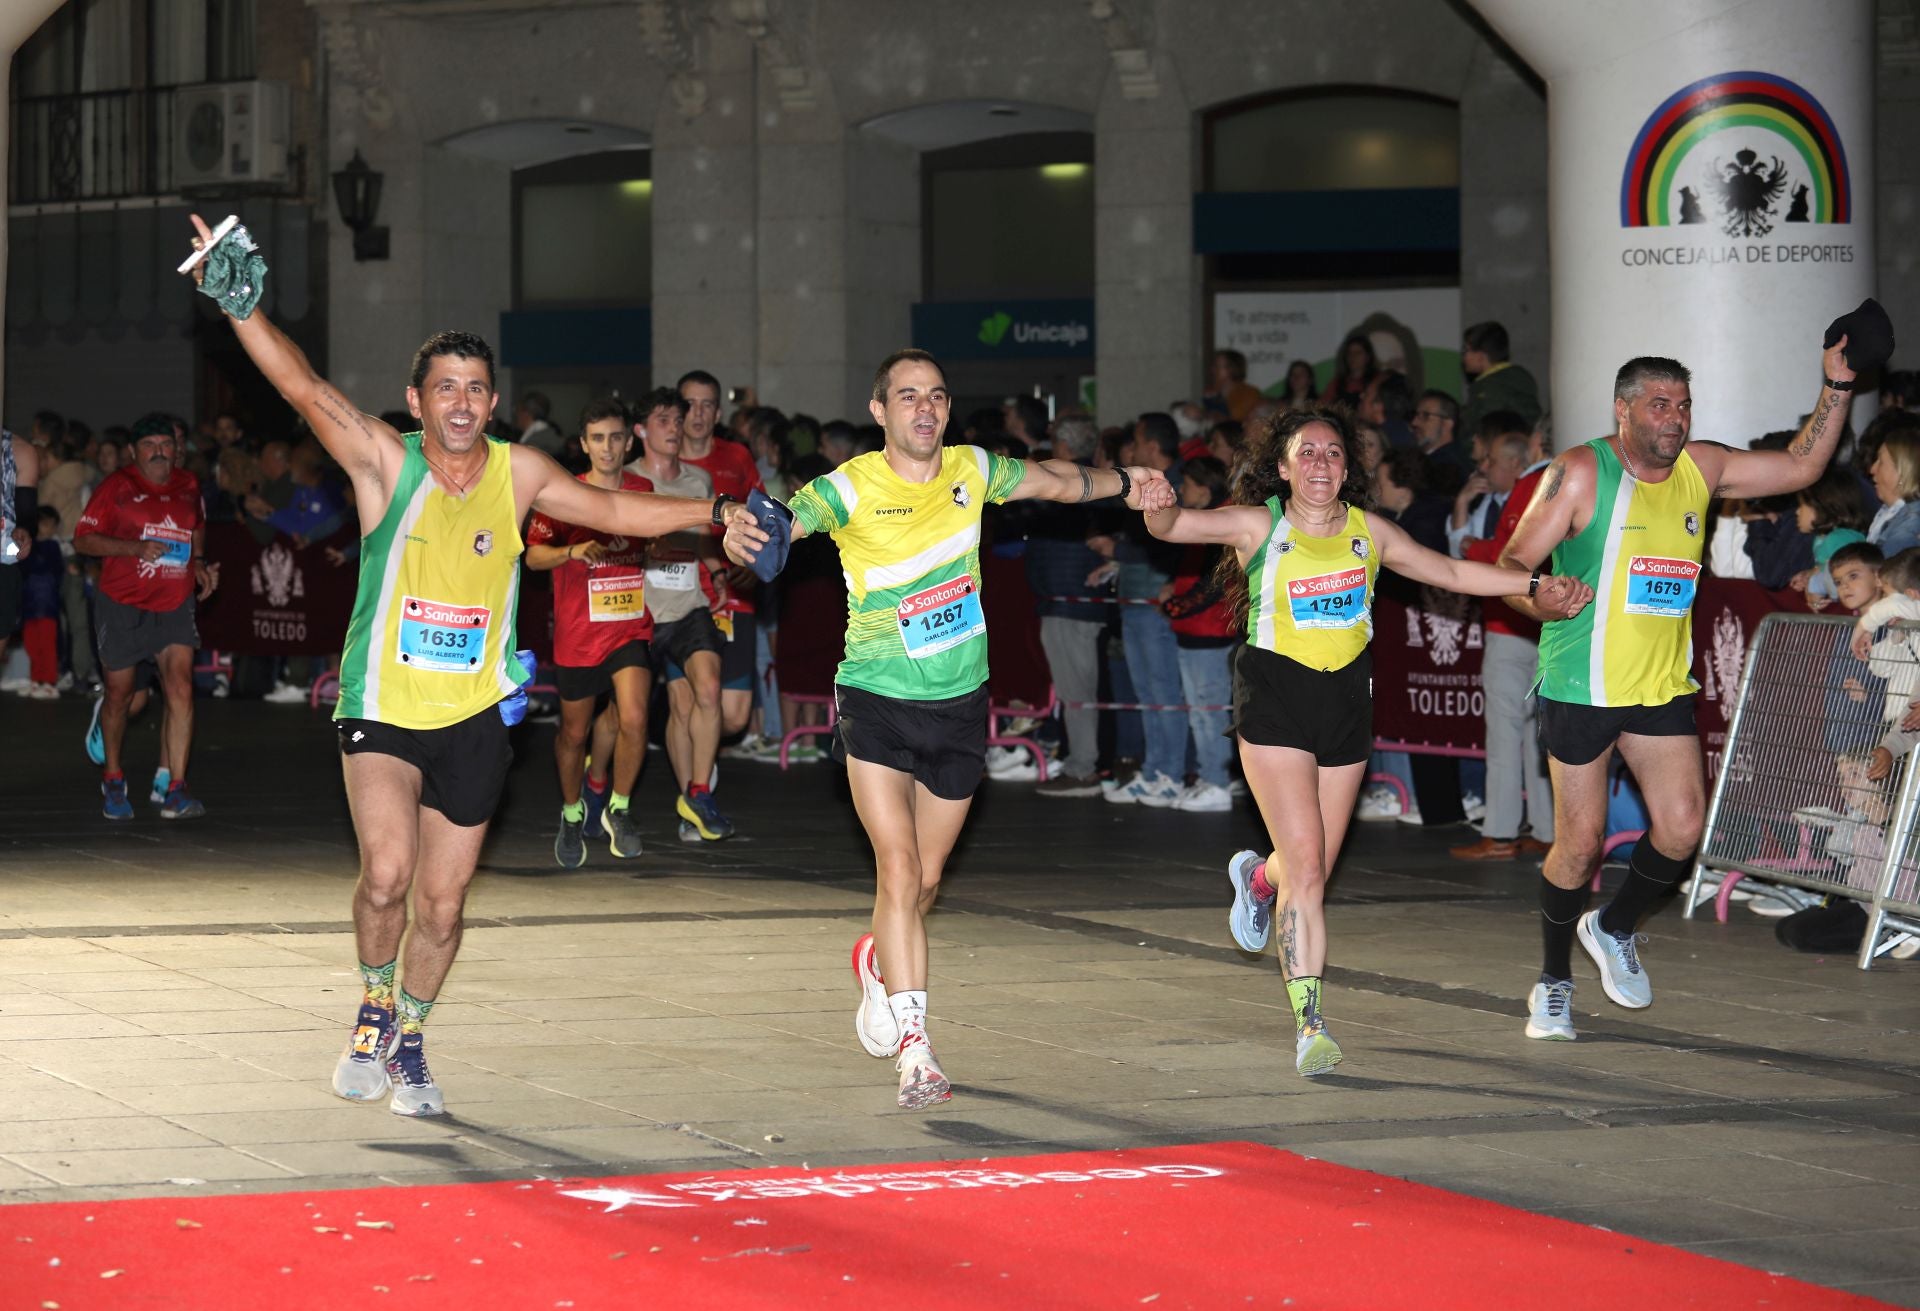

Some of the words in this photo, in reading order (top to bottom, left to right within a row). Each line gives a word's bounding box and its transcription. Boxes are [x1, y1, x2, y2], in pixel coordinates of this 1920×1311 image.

[1621, 247, 1740, 266] CONCEJALIA
[1746, 246, 1771, 264] DE
[1776, 245, 1854, 263] DEPORTES
[1227, 309, 1246, 325] Te
[1013, 320, 1089, 347] Unicaja
[1239, 331, 1252, 345] la
[1256, 331, 1289, 345] vida
[875, 506, 914, 516] evernya
[659, 564, 687, 574] 4607
[1647, 561, 1697, 576] Santander
[603, 580, 642, 590] Santander
[1308, 573, 1366, 593] Santander
[1645, 580, 1681, 595] 1679
[603, 593, 633, 605] 2132
[915, 580, 973, 609] Santander
[1309, 594, 1353, 612] 1794
[423, 606, 488, 625] Santander
[920, 603, 963, 631] 1267
[253, 619, 307, 642] TOLEDO
[419, 628, 468, 648] 1633
[924, 629, 949, 643] CARLOS
[950, 620, 969, 634] JAVIER
[417, 648, 434, 656] LUIS
[435, 651, 465, 659] ALBERTO
[1407, 688, 1485, 716] TOLEDO
[701, 1164, 1226, 1202] Gesprodex
